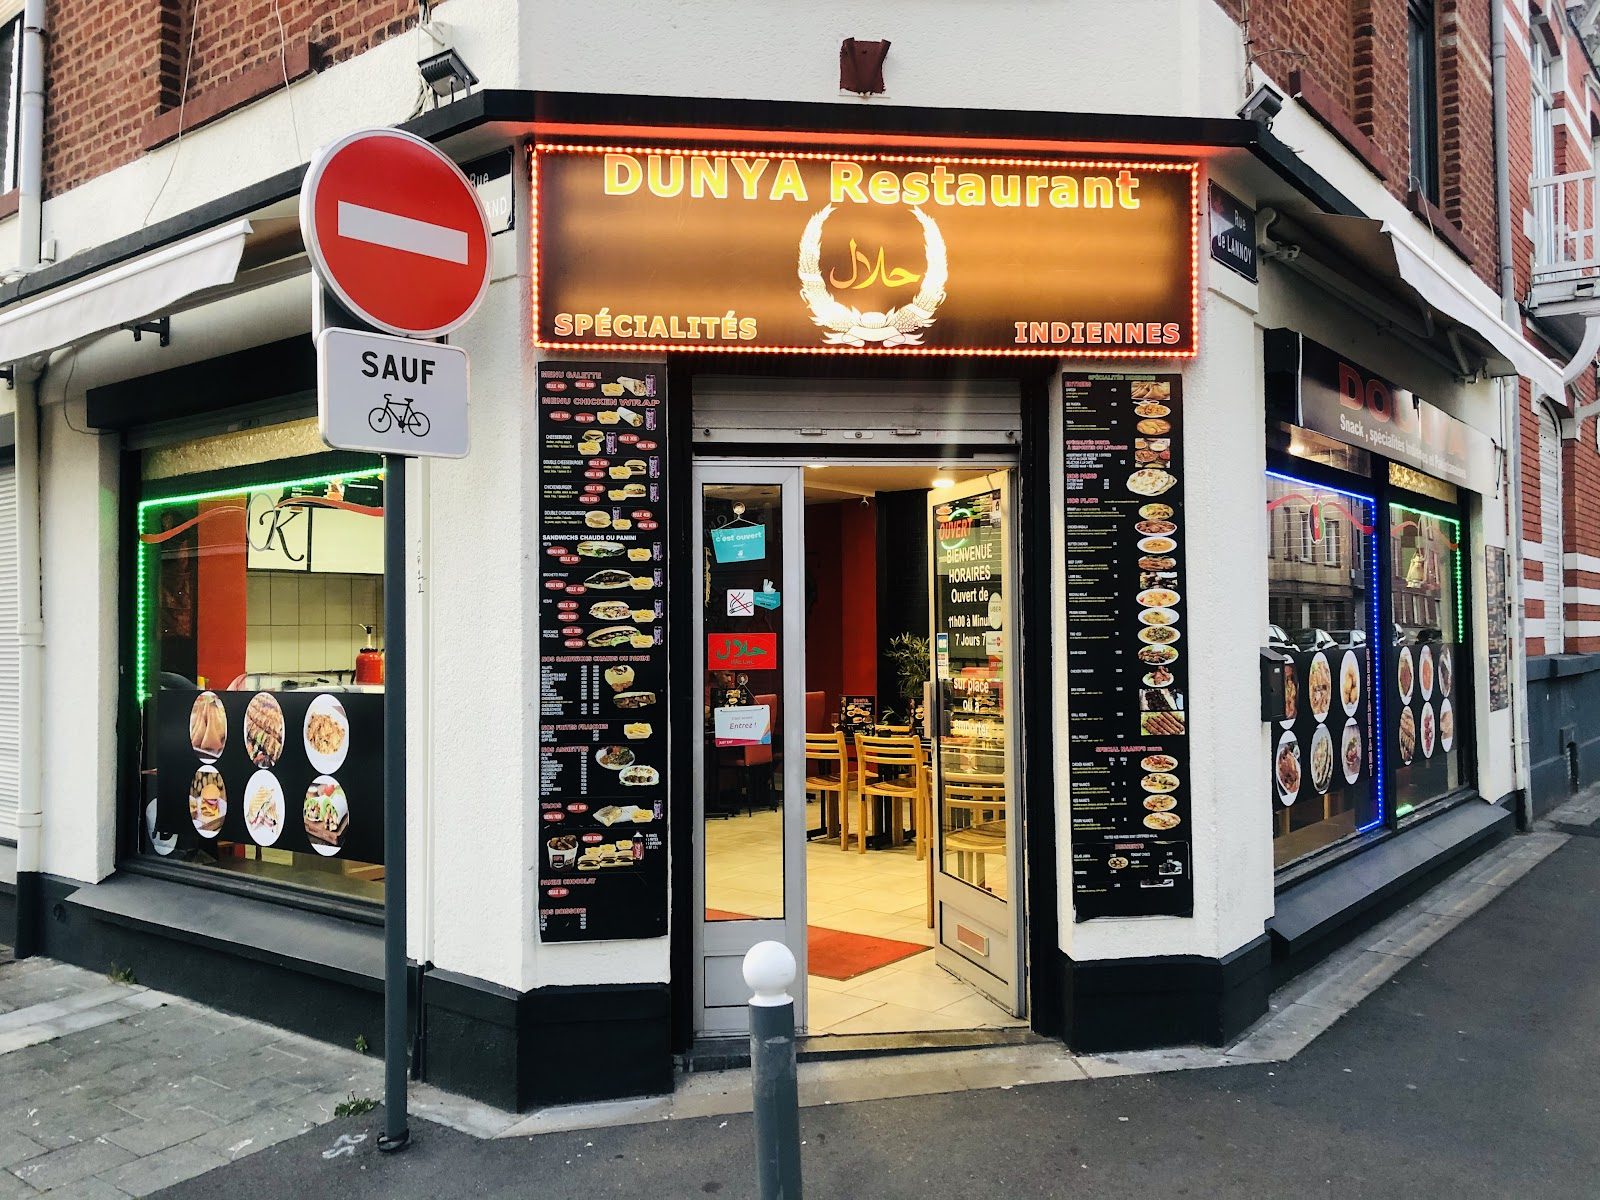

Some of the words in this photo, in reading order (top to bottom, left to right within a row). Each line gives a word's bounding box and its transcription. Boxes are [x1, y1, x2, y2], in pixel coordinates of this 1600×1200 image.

[469, 172, 489, 188] Rue
[604, 153, 808, 201] DUNYA
[830, 161, 1140, 209] Restaurant
[485, 196, 508, 219] AND
[1234, 209, 1246, 232] Rue
[1217, 233, 1225, 249] de
[1227, 235, 1252, 265] LANNOY
[829, 237, 921, 290] حلال
[554, 307, 758, 340] SPÉCIALITÉS
[1014, 321, 1181, 345] INDIENNES
[361, 351, 436, 385] SAUF
[541, 397, 571, 405] MENU
[573, 398, 617, 406] CHICKEN
[1340, 413, 1364, 438] Snack
[1369, 428, 1405, 454] spécialités
[736, 531, 762, 540] ouvert
[938, 518, 972, 540] OUVERT
[946, 543, 993, 564] BIENVENUE
[948, 564, 991, 583] HORAIRES
[951, 587, 977, 603] Ouvert
[978, 586, 989, 601] de
[948, 615, 965, 629] 11h00
[966, 614, 970, 628] à
[972, 614, 991, 627] Minu
[716, 640, 767, 659] حلال
[955, 633, 959, 646] 7
[961, 633, 981, 647] Jours
[953, 679, 965, 690] sur
[967, 678, 989, 694] place
[729, 722, 753, 730] Entrez
